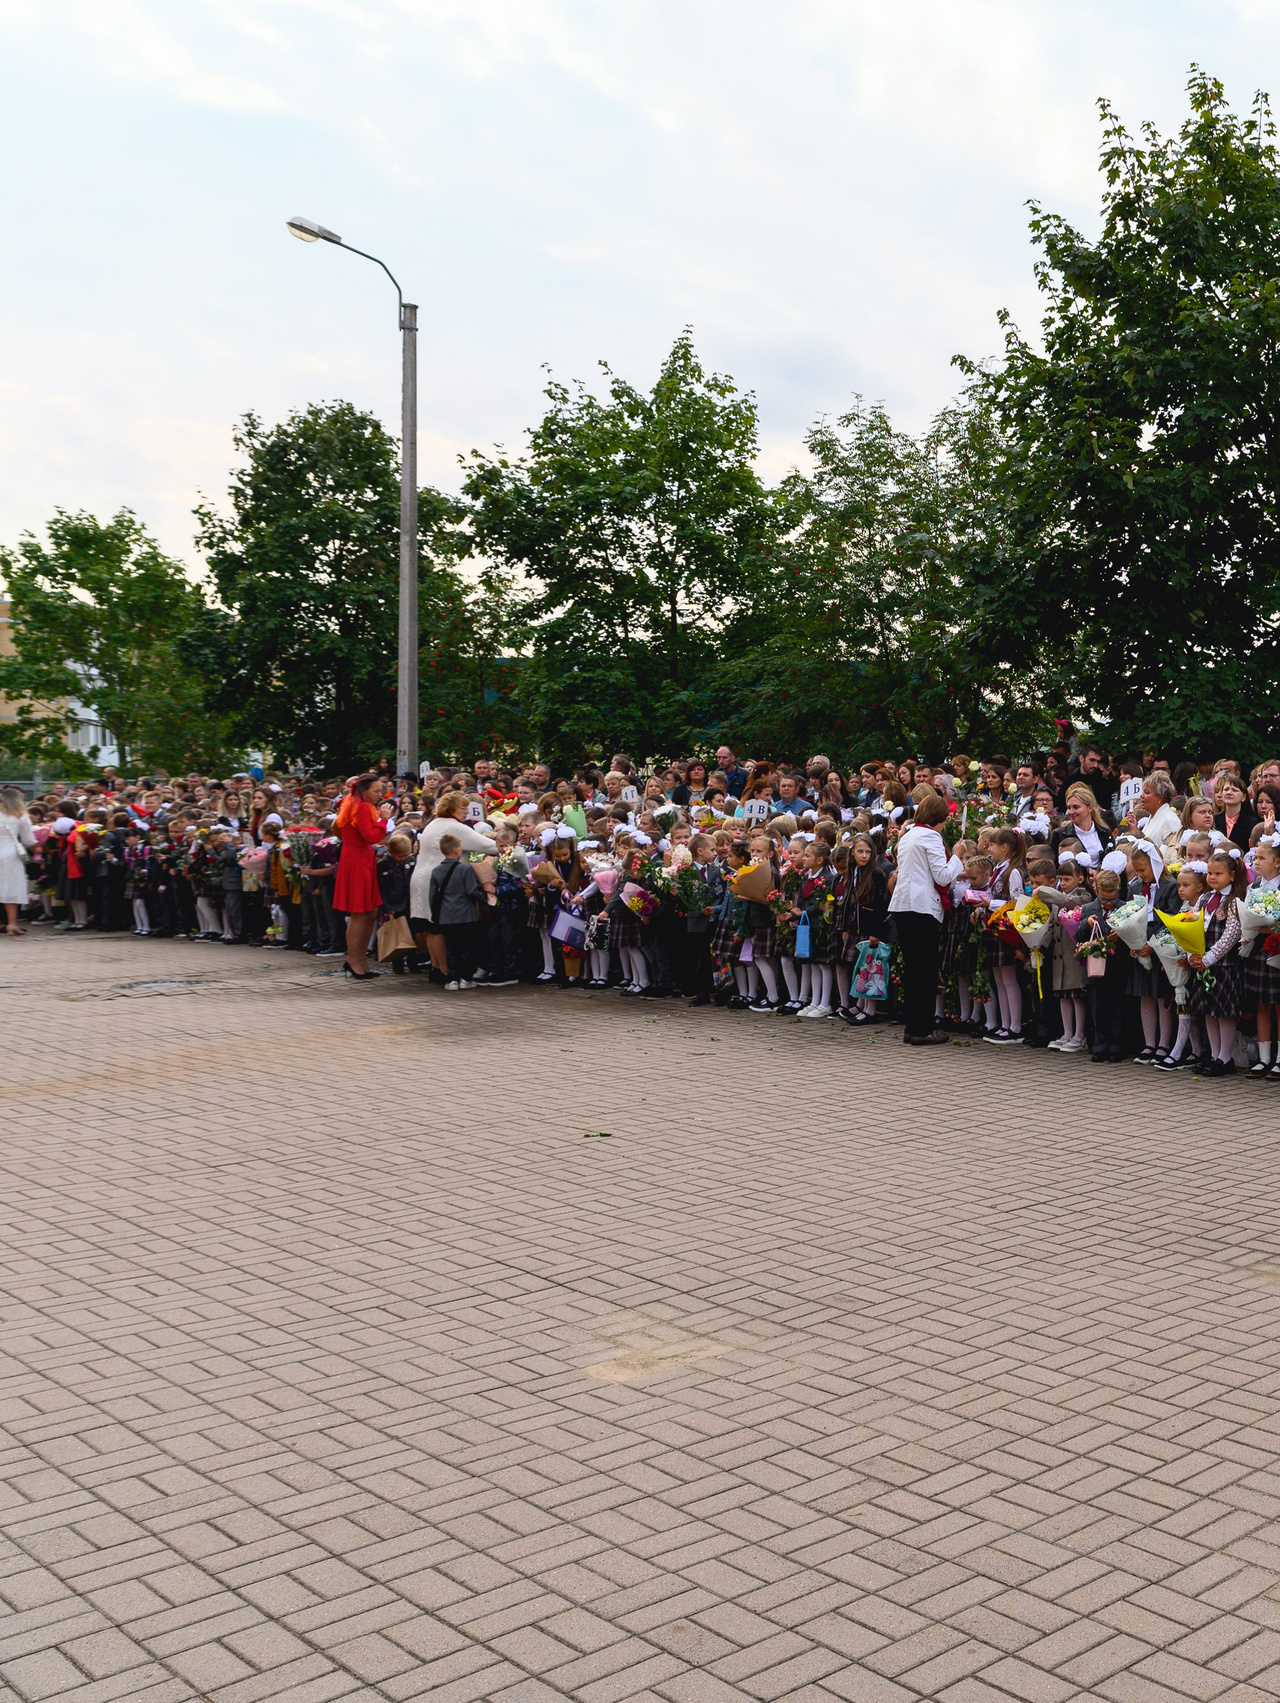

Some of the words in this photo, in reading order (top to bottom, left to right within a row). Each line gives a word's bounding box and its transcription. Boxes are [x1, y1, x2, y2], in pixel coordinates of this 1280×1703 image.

[1123, 786, 1129, 796] 4
[1133, 783, 1140, 794] Б
[624, 791, 628, 800] 4
[472, 807, 480, 817] Б
[747, 804, 753, 813] 4
[757, 804, 765, 814] В
